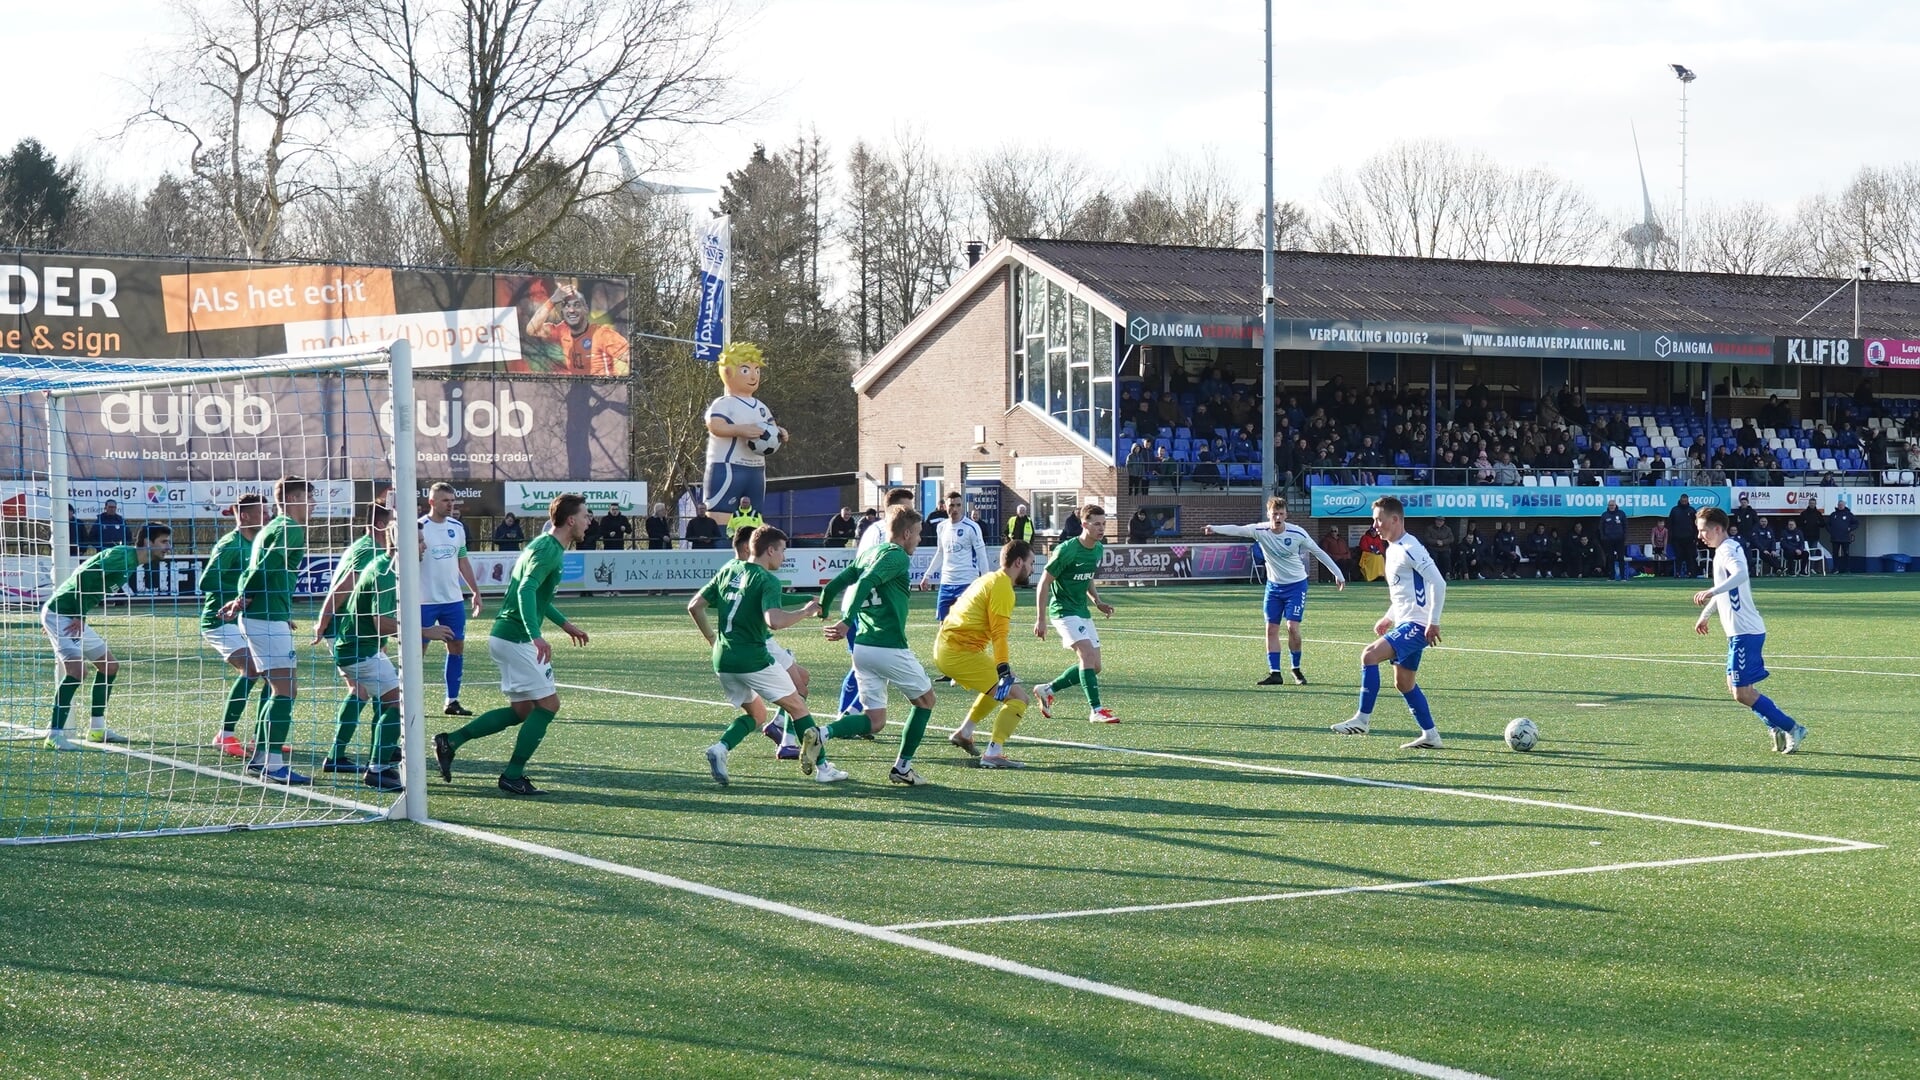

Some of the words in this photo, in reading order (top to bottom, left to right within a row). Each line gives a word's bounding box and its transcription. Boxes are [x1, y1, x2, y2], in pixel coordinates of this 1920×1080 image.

[191, 286, 240, 313] Als
[247, 284, 296, 309] het
[303, 278, 367, 306] echt
[31, 325, 55, 350] &
[62, 326, 120, 357] sign
[1309, 328, 1382, 342] VERPAKKING
[1386, 331, 1429, 344] NODIG?
[1462, 334, 1626, 351] WWW.BANGMAVERPAKKING.NL
[1787, 339, 1849, 365] KLIF18
[100, 385, 272, 445] dujob
[380, 388, 534, 449] ujob
[101, 449, 139, 460] Jouw
[142, 449, 177, 460] baan
[201, 452, 231, 460] onze
[234, 449, 271, 460] radar
[417, 451, 448, 462] baan
[451, 454, 467, 464] op
[471, 454, 500, 462] onze
[502, 451, 534, 462] radar
[96, 487, 137, 499] nodig?
[168, 489, 185, 501] GT
[583, 491, 618, 500] STRAK
[1798, 491, 1818, 499] ALPHA
[1856, 493, 1916, 505] HOEKSTRA
[1323, 494, 1361, 506] Seacon
[1437, 494, 1476, 508] VOOR
[1480, 494, 1510, 510] VIS,
[1512, 494, 1562, 507] PASSIE
[1566, 494, 1605, 507] VOOR
[1689, 495, 1715, 505] eacon
[1100, 549, 1124, 567] De
[1129, 549, 1171, 571] Kaap
[625, 569, 649, 582] JAN
[652, 570, 664, 580] de
[724, 592, 742, 634] 7
